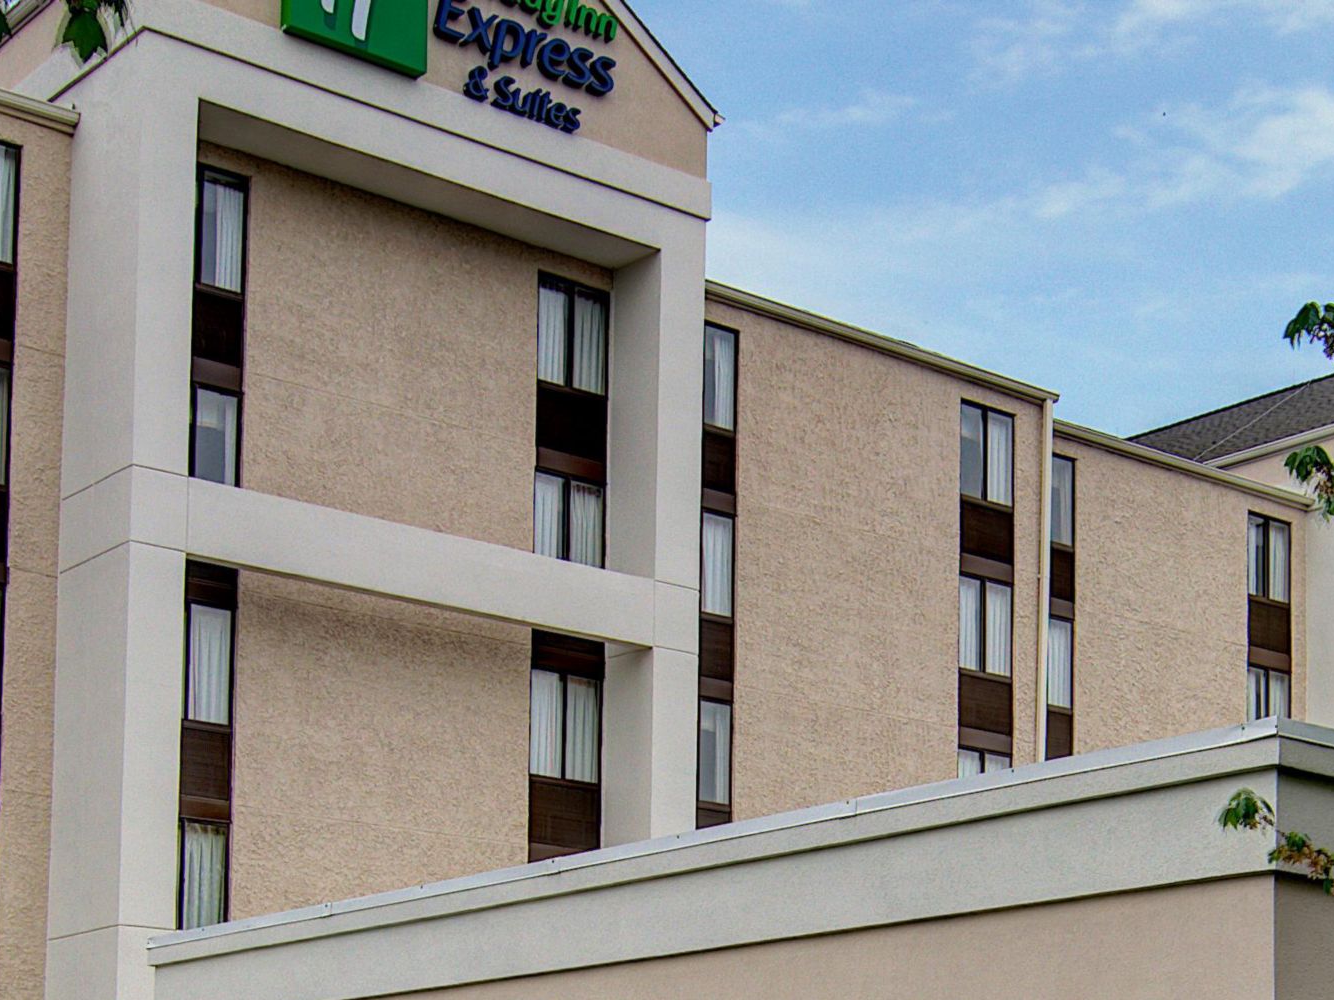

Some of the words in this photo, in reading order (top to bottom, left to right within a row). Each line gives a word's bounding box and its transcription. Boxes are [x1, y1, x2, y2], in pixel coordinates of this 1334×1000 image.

[433, 0, 616, 97] Express
[463, 65, 489, 102] &
[491, 76, 581, 134] Suites
